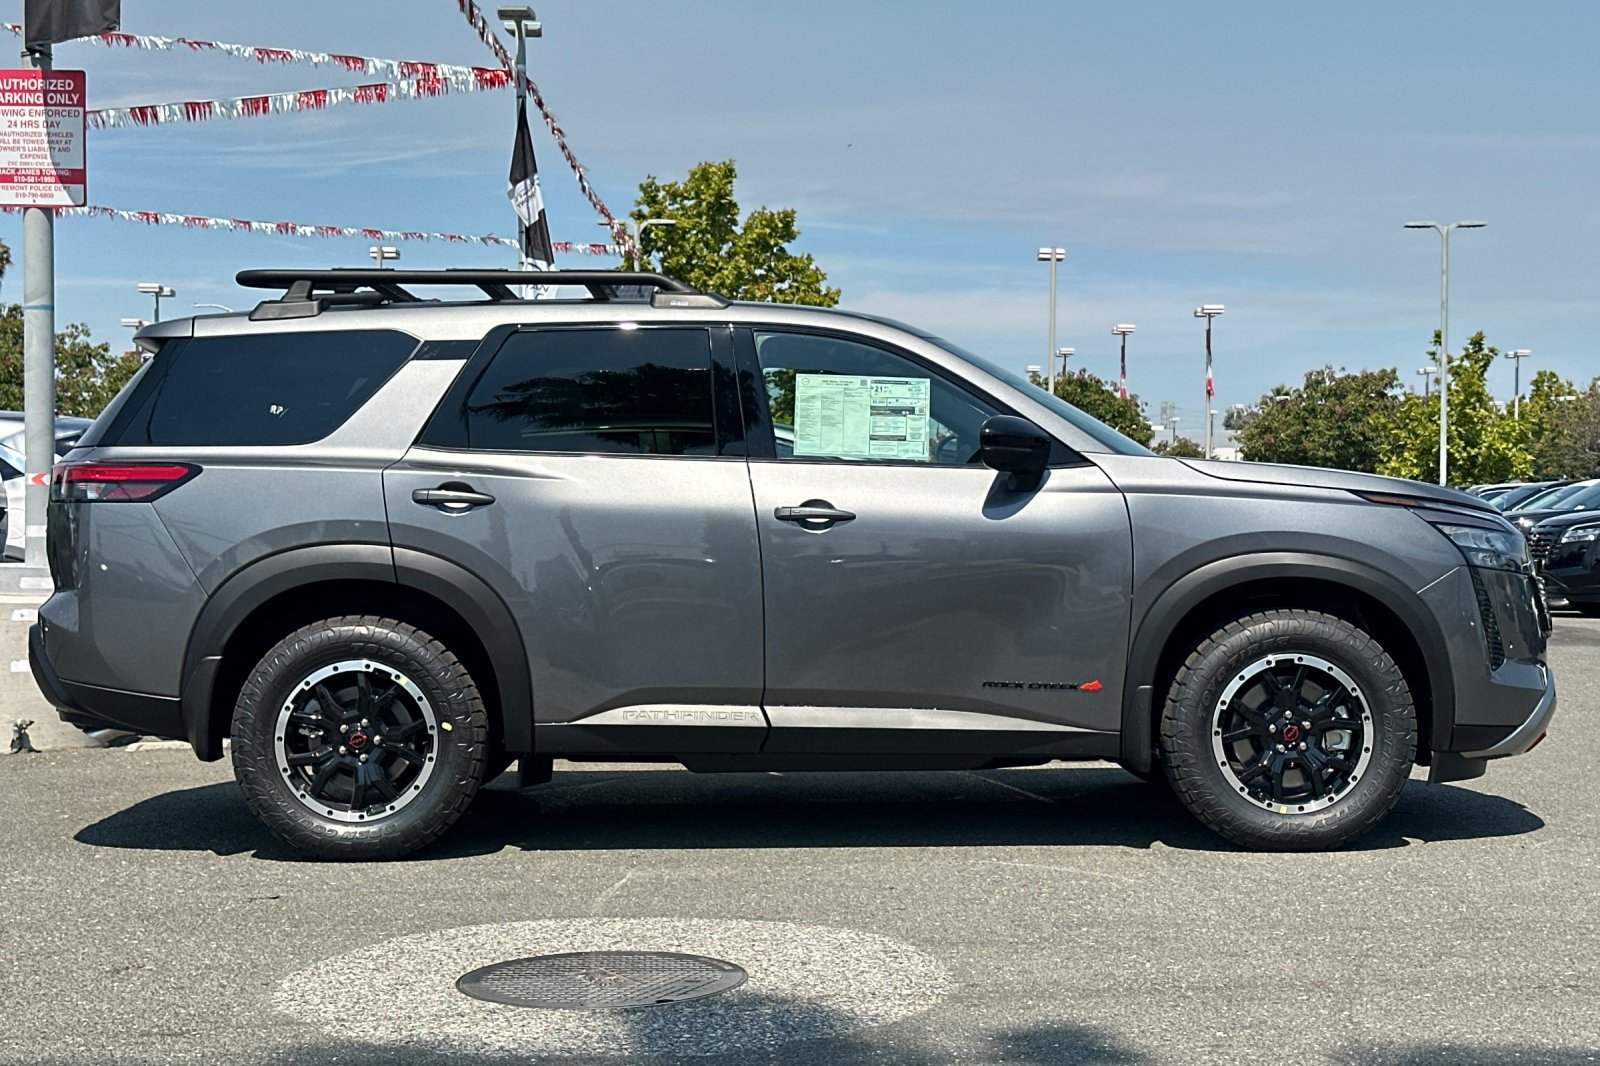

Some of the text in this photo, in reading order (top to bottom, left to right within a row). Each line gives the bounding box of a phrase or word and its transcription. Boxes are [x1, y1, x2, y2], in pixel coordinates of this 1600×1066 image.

[47, 93, 80, 104] ONLY
[0, 109, 80, 118] WING ENFORCED
[622, 710, 760, 721] PATHFINDER
